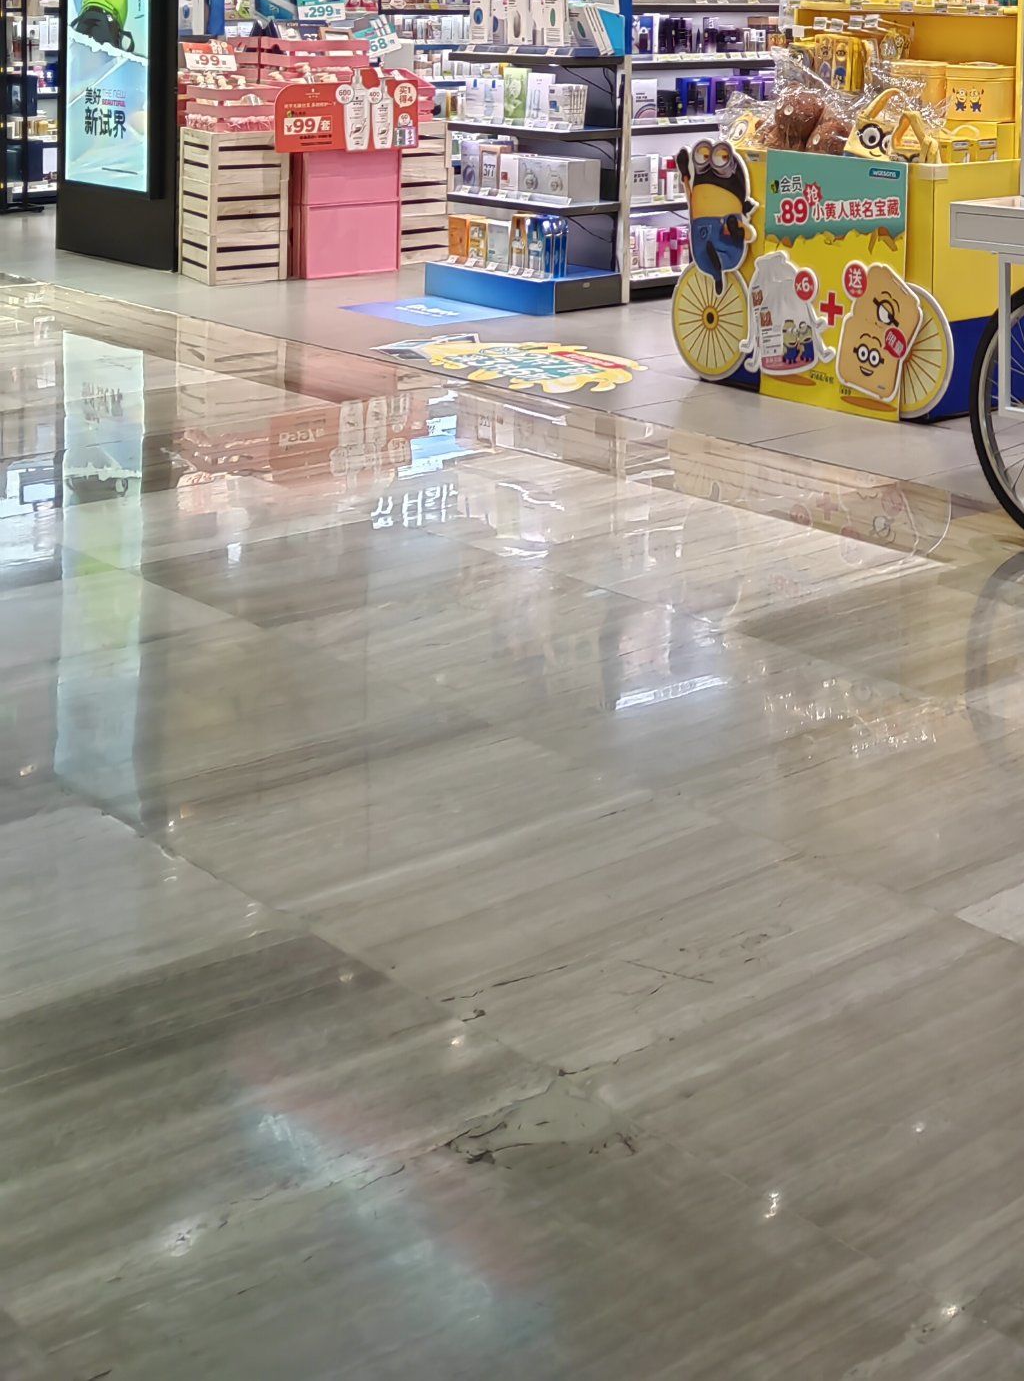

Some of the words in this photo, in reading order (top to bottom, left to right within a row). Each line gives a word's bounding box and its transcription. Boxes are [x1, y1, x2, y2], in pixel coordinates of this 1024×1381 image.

[84, 106, 127, 139] 新试界
[781, 176, 802, 193] 会员
[812, 198, 900, 221] 小黄人联名宝藏
[848, 267, 863, 289] 送
